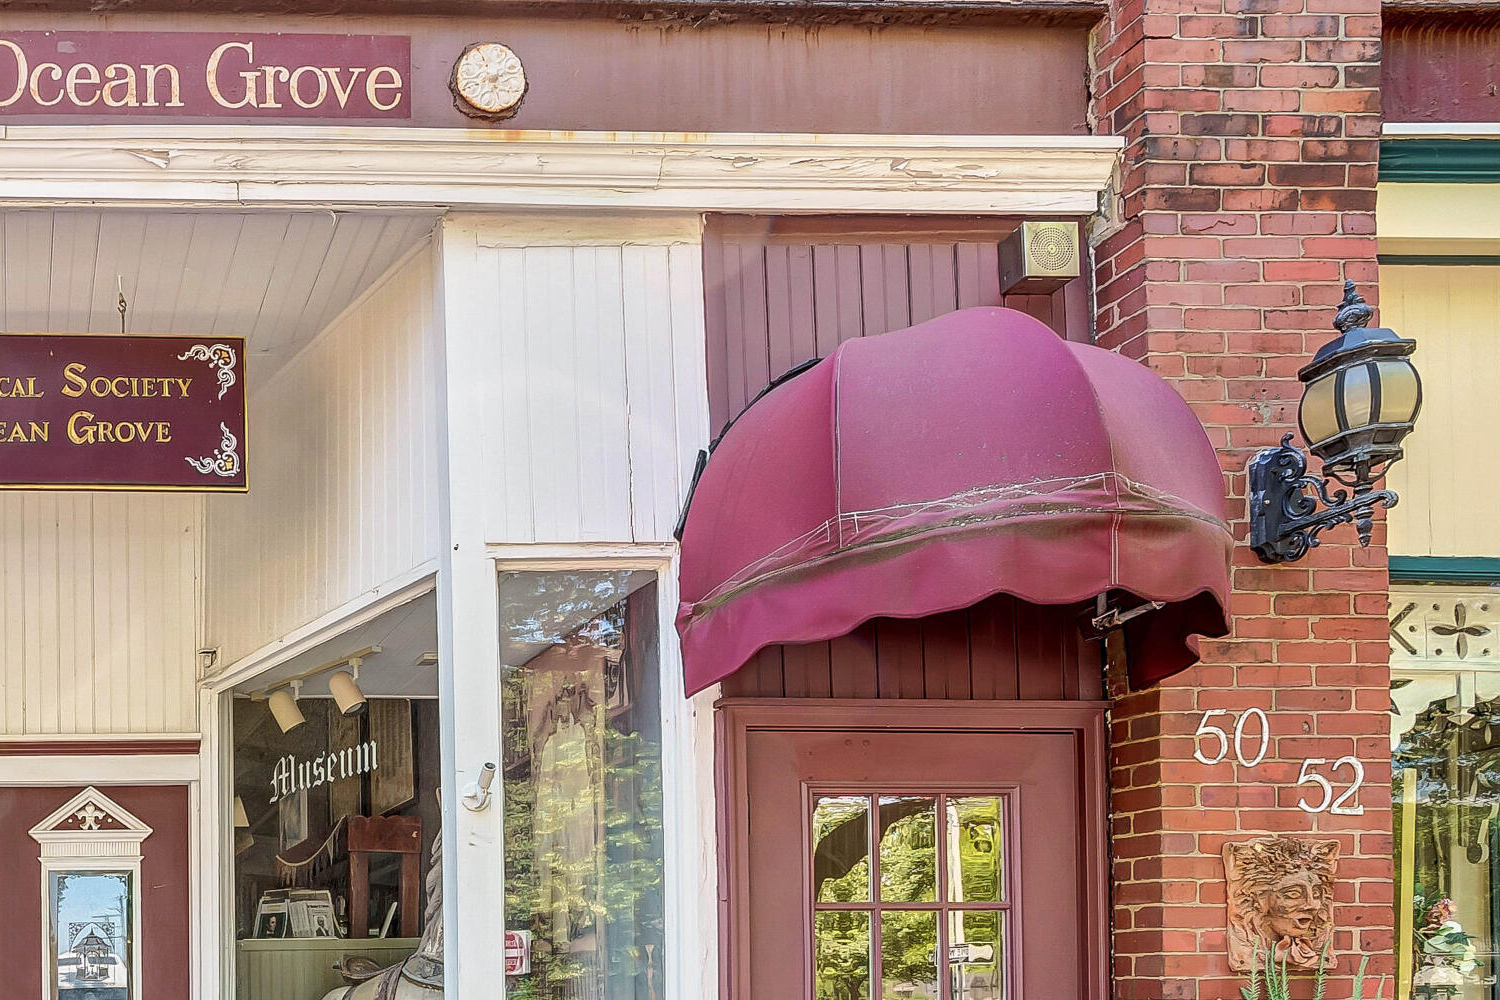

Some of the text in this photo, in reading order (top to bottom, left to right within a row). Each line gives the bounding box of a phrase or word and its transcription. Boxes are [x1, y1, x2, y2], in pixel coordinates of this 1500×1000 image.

[205, 40, 403, 111] Grove
[60, 362, 193, 399] SOCIETY
[66, 410, 172, 445] GROVE
[1193, 707, 1270, 768] 50
[269, 740, 379, 805] Museum
[1297, 755, 1365, 816] 52
